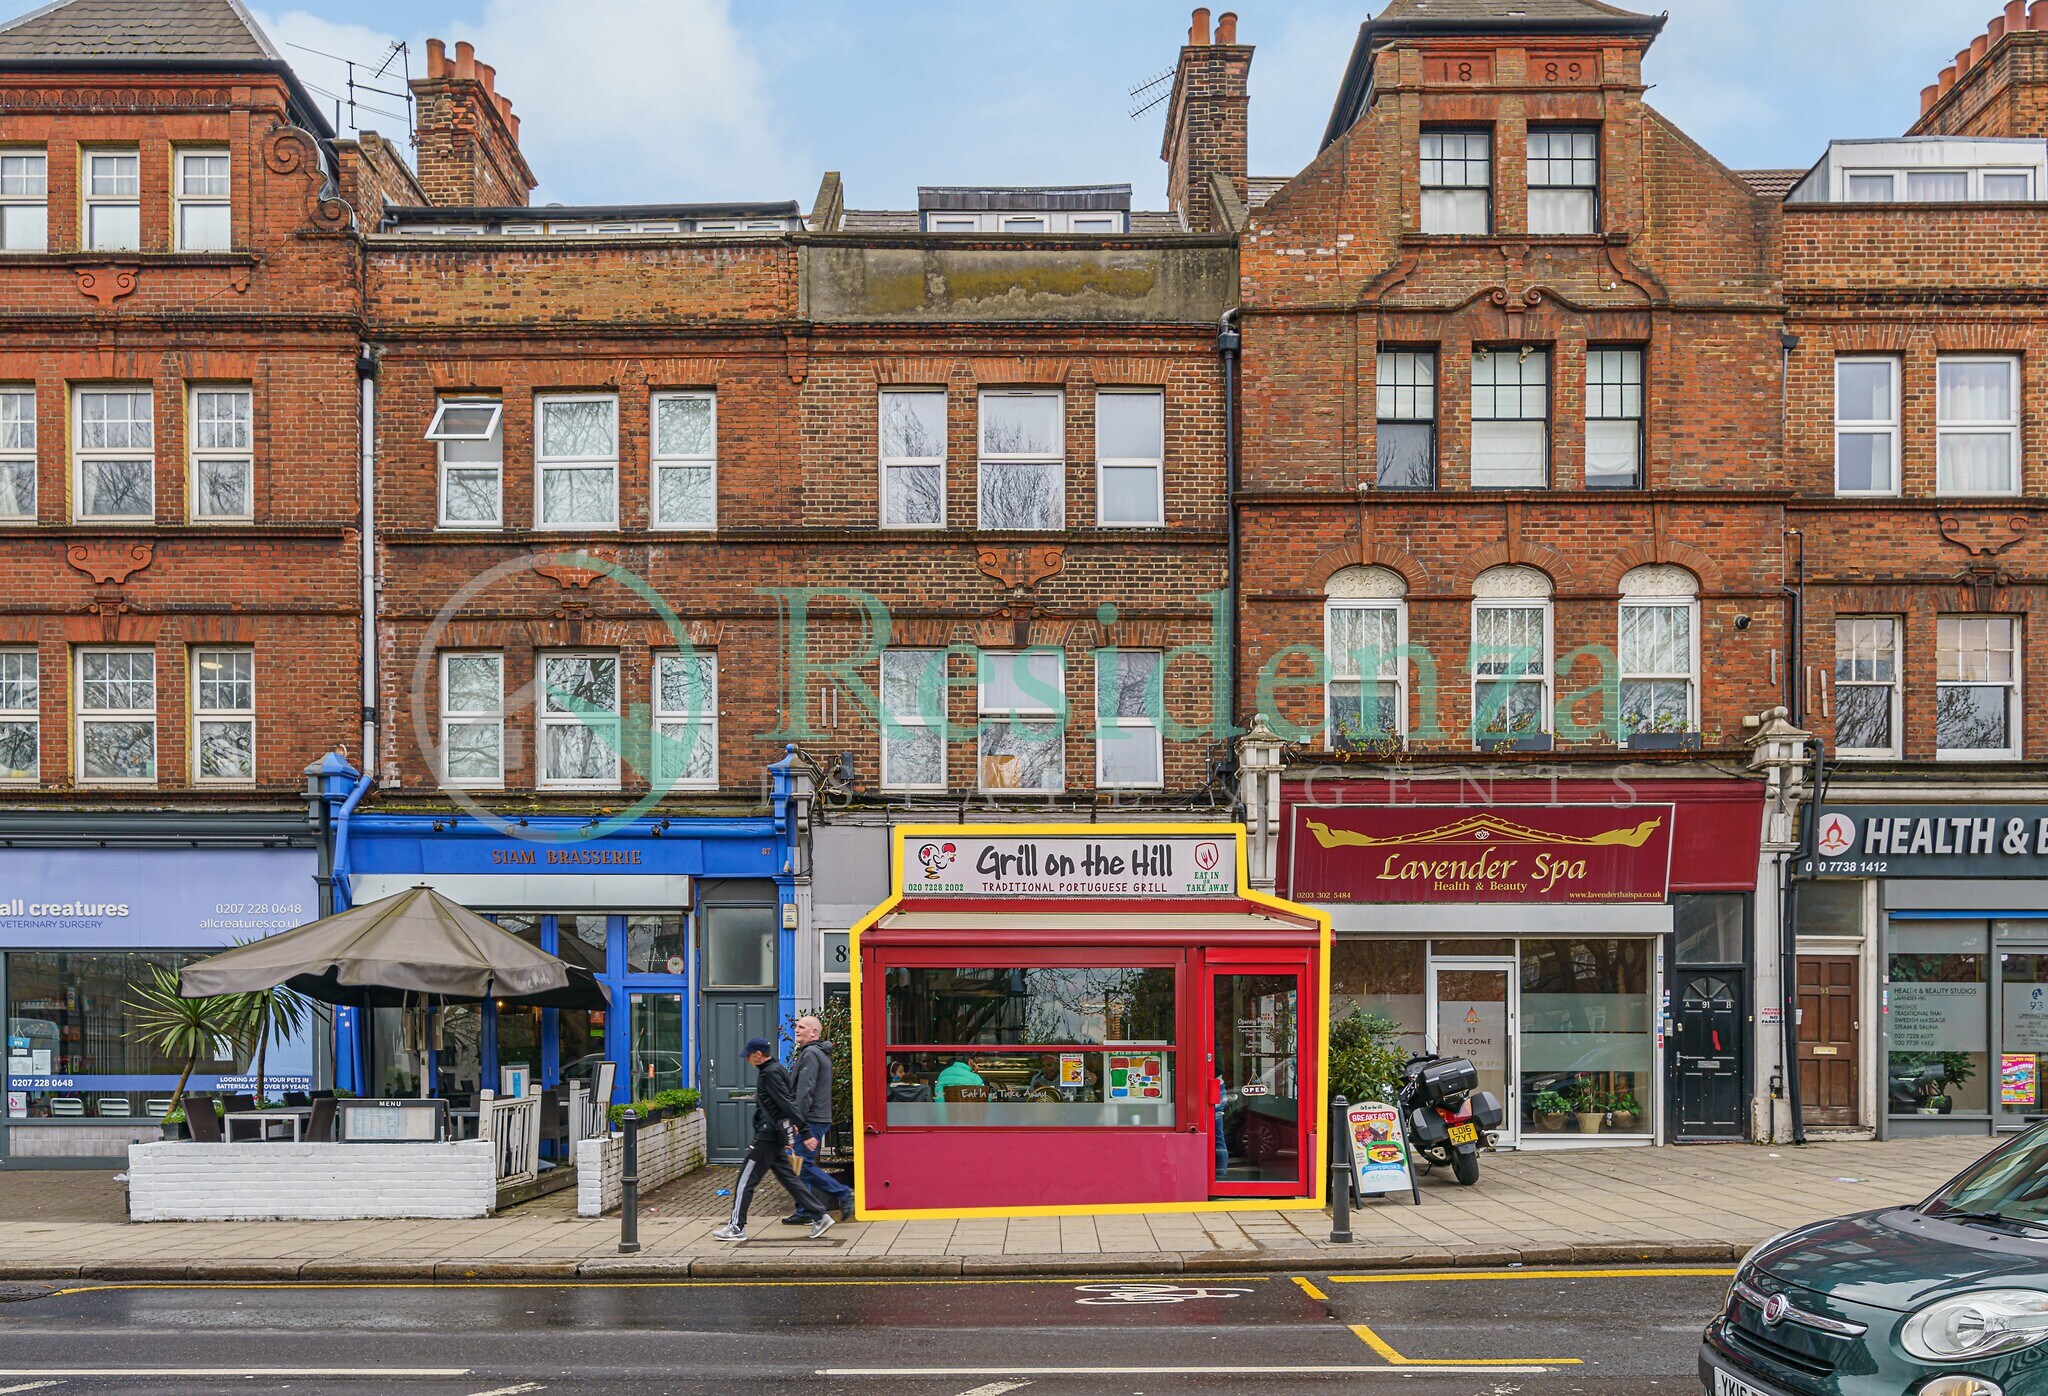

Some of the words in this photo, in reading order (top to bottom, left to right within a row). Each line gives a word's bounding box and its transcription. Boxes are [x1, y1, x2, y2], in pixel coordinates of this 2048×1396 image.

[1443, 62, 1472, 82] 18
[1544, 62, 1582, 82] 89
[1864, 817, 1996, 854] HEALTH
[2002, 817, 2030, 855] &
[492, 850, 536, 864] SIAM
[547, 850, 642, 864] BRASSERIE
[976, 844, 1038, 880] Grill
[1045, 853, 1075, 877] on
[1081, 844, 1125, 877] the
[1132, 843, 1173, 877] Hill
[1376, 846, 1518, 880] Lavender
[1531, 852, 1588, 893] Spa
[1805, 861, 1826, 872] 00
[1829, 861, 1857, 872] 7738
[1860, 861, 1887, 872] 1412
[1194, 872, 1208, 880] EAT
[1210, 872, 1219, 880] IN
[908, 883, 922, 892] 020
[924, 883, 943, 892] 7228
[945, 883, 964, 892] 2002
[982, 882, 1054, 892] TRADITIONAL
[1059, 882, 1128, 892] PORTUGUESE
[1133, 882, 1168, 893] GRILL
[1186, 884, 1206, 892] TAKE
[1208, 884, 1229, 892] AWAY
[1433, 881, 1470, 891] Health
[1475, 882, 1485, 891] &
[1490, 881, 1528, 893] Beauty
[1569, 891, 1662, 900] www.lavenderthaispa.co.uk
[0, 899, 24, 917] all
[29, 901, 130, 917] creatures
[215, 903, 244, 914] 0207
[247, 903, 269, 914] 228
[271, 903, 302, 914] 0648
[200, 919, 302, 928] allcreatures.co.uk
[1702, 1001, 1710, 1009] 91
[2030, 1001, 2043, 1010] 93
[1237, 1018, 1257, 1026] Opening
[12, 1079, 32, 1087] 0207
[34, 1079, 50, 1087] 228
[51, 1079, 73, 1087] 0648
[961, 1088, 979, 1098] Eat
[979, 1088, 987, 1098] In
[998, 1089, 1021, 1098] Take
[1023, 1089, 1047, 1099] Away
[1352, 1112, 1395, 1122] BREAKFASTS
[1455, 1132, 1472, 1143] ZYT
[1766, 1302, 1779, 1315] FIAT
